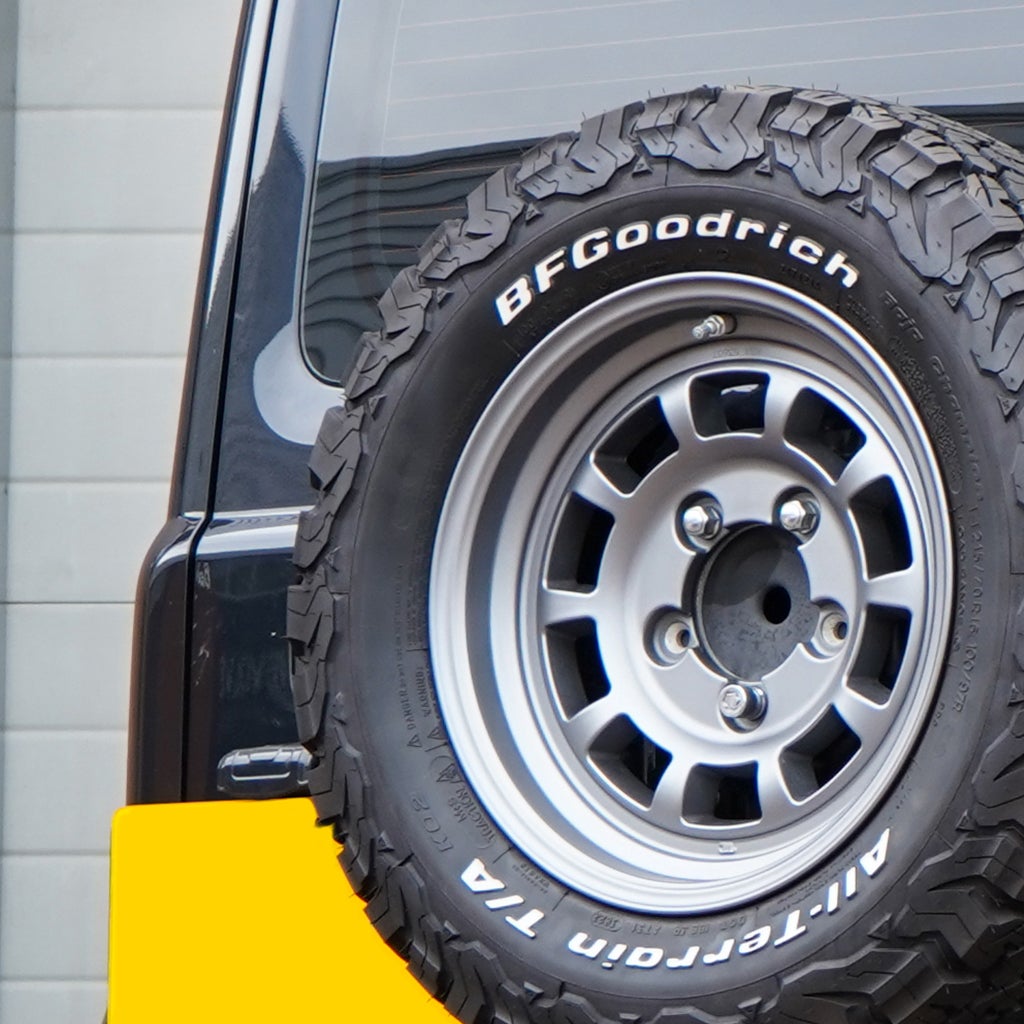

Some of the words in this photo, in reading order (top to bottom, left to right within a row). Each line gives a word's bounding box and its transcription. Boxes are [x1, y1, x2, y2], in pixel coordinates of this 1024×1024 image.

[495, 209, 859, 326] BFGoodrich
[460, 857, 545, 938] T/A
[568, 828, 891, 969] All-Terrain
